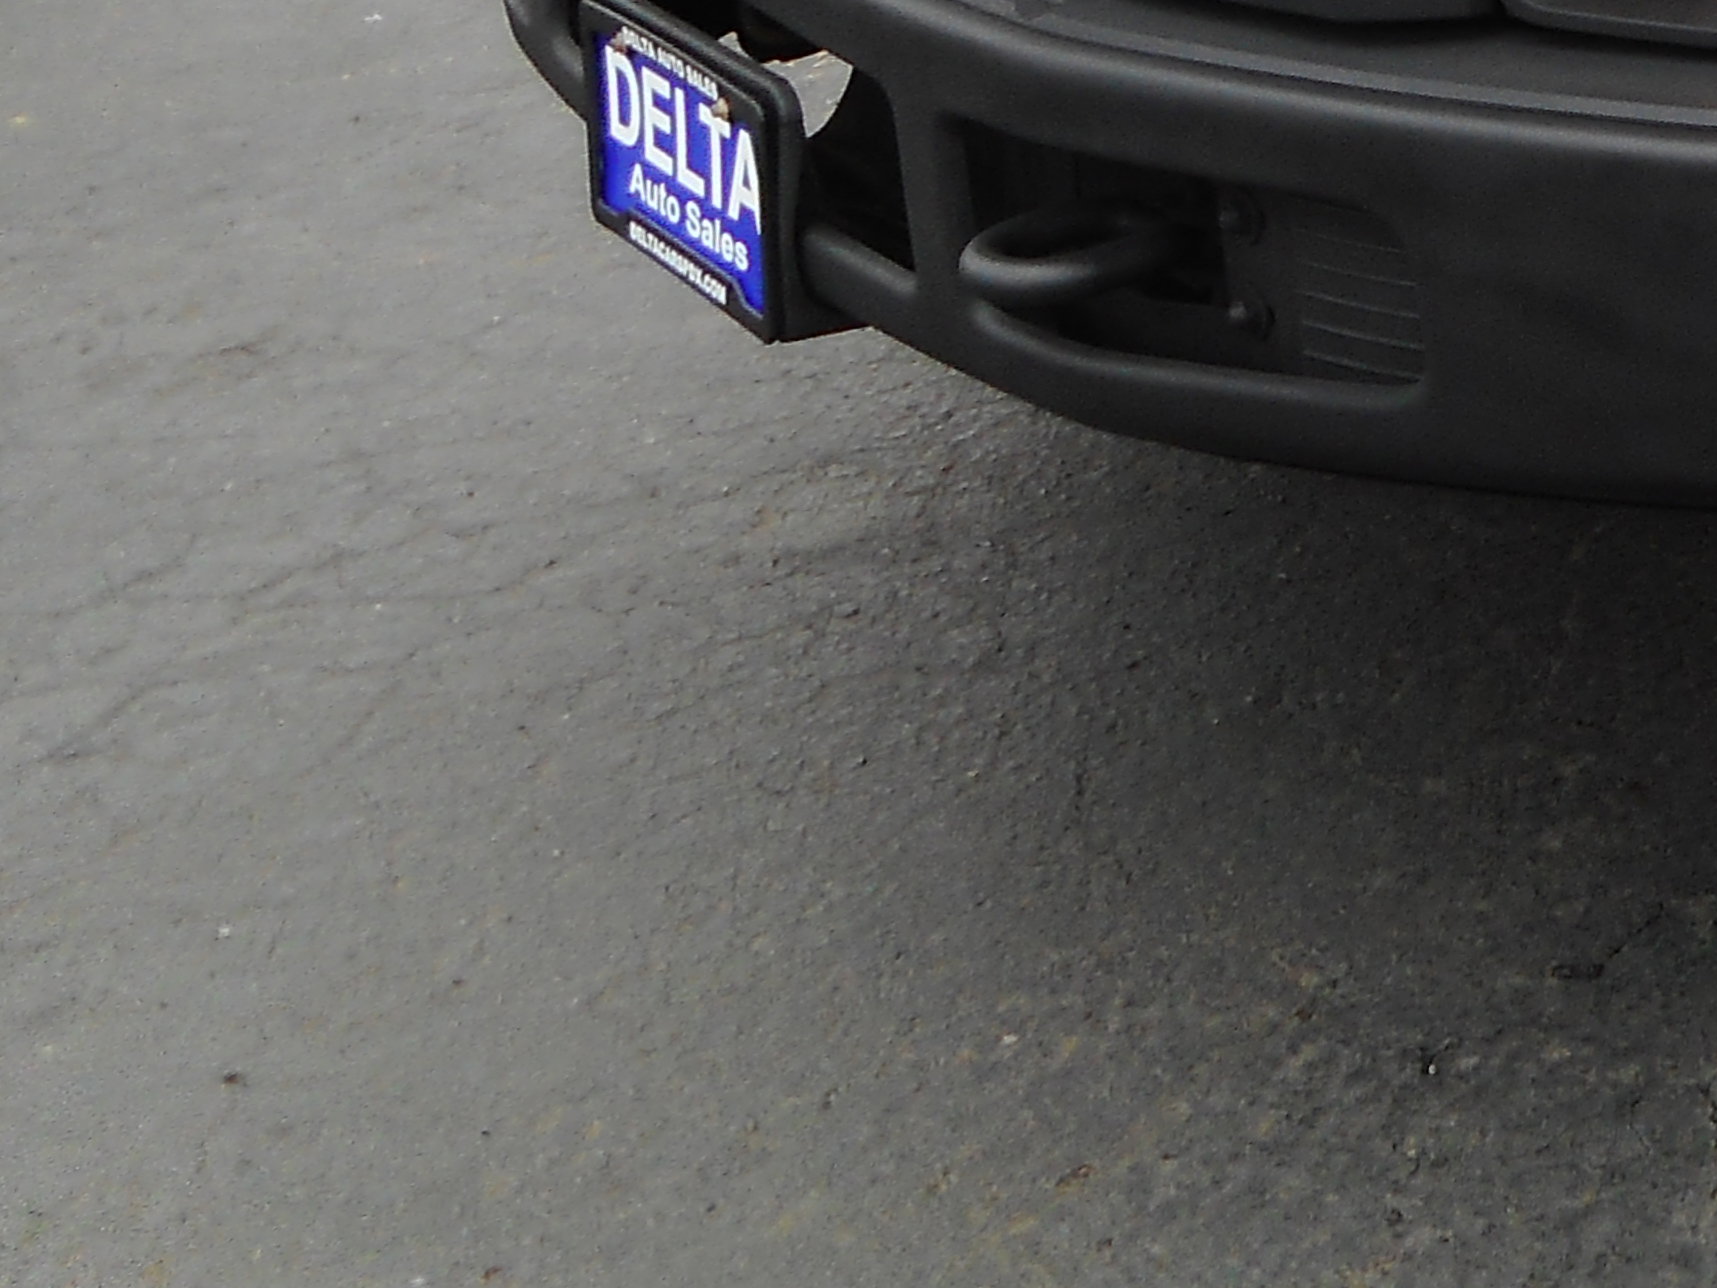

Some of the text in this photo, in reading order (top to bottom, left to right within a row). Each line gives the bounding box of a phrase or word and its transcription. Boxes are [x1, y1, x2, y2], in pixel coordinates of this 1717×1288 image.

[604, 43, 762, 237] DELTA
[630, 163, 749, 272] Auto Sales
